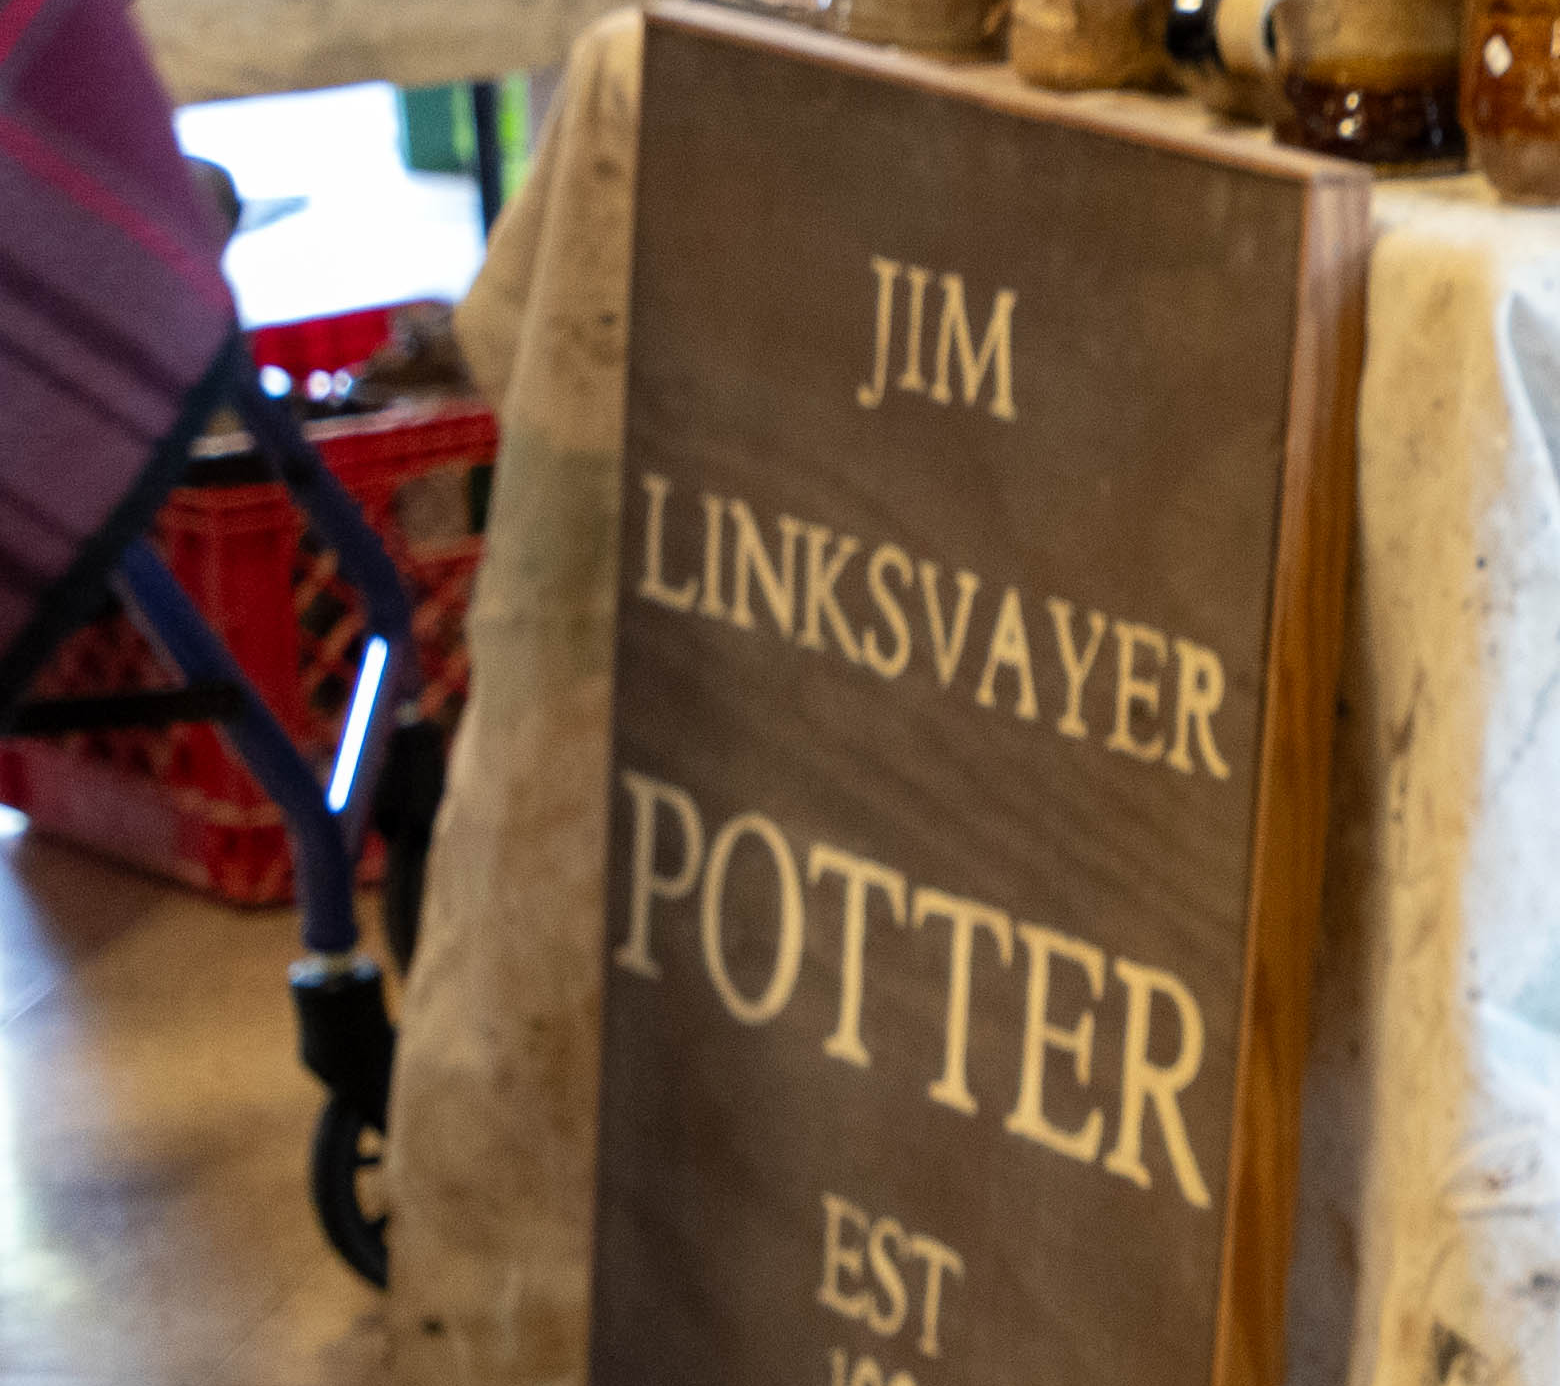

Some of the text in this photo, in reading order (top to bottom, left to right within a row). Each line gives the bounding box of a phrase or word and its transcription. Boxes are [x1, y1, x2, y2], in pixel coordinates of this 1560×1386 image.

[858, 256, 1017, 419] JIM
[639, 474, 1229, 779] LINKSVAYER
[616, 773, 1212, 1208] POTTER
[819, 1193, 962, 1354] EST
